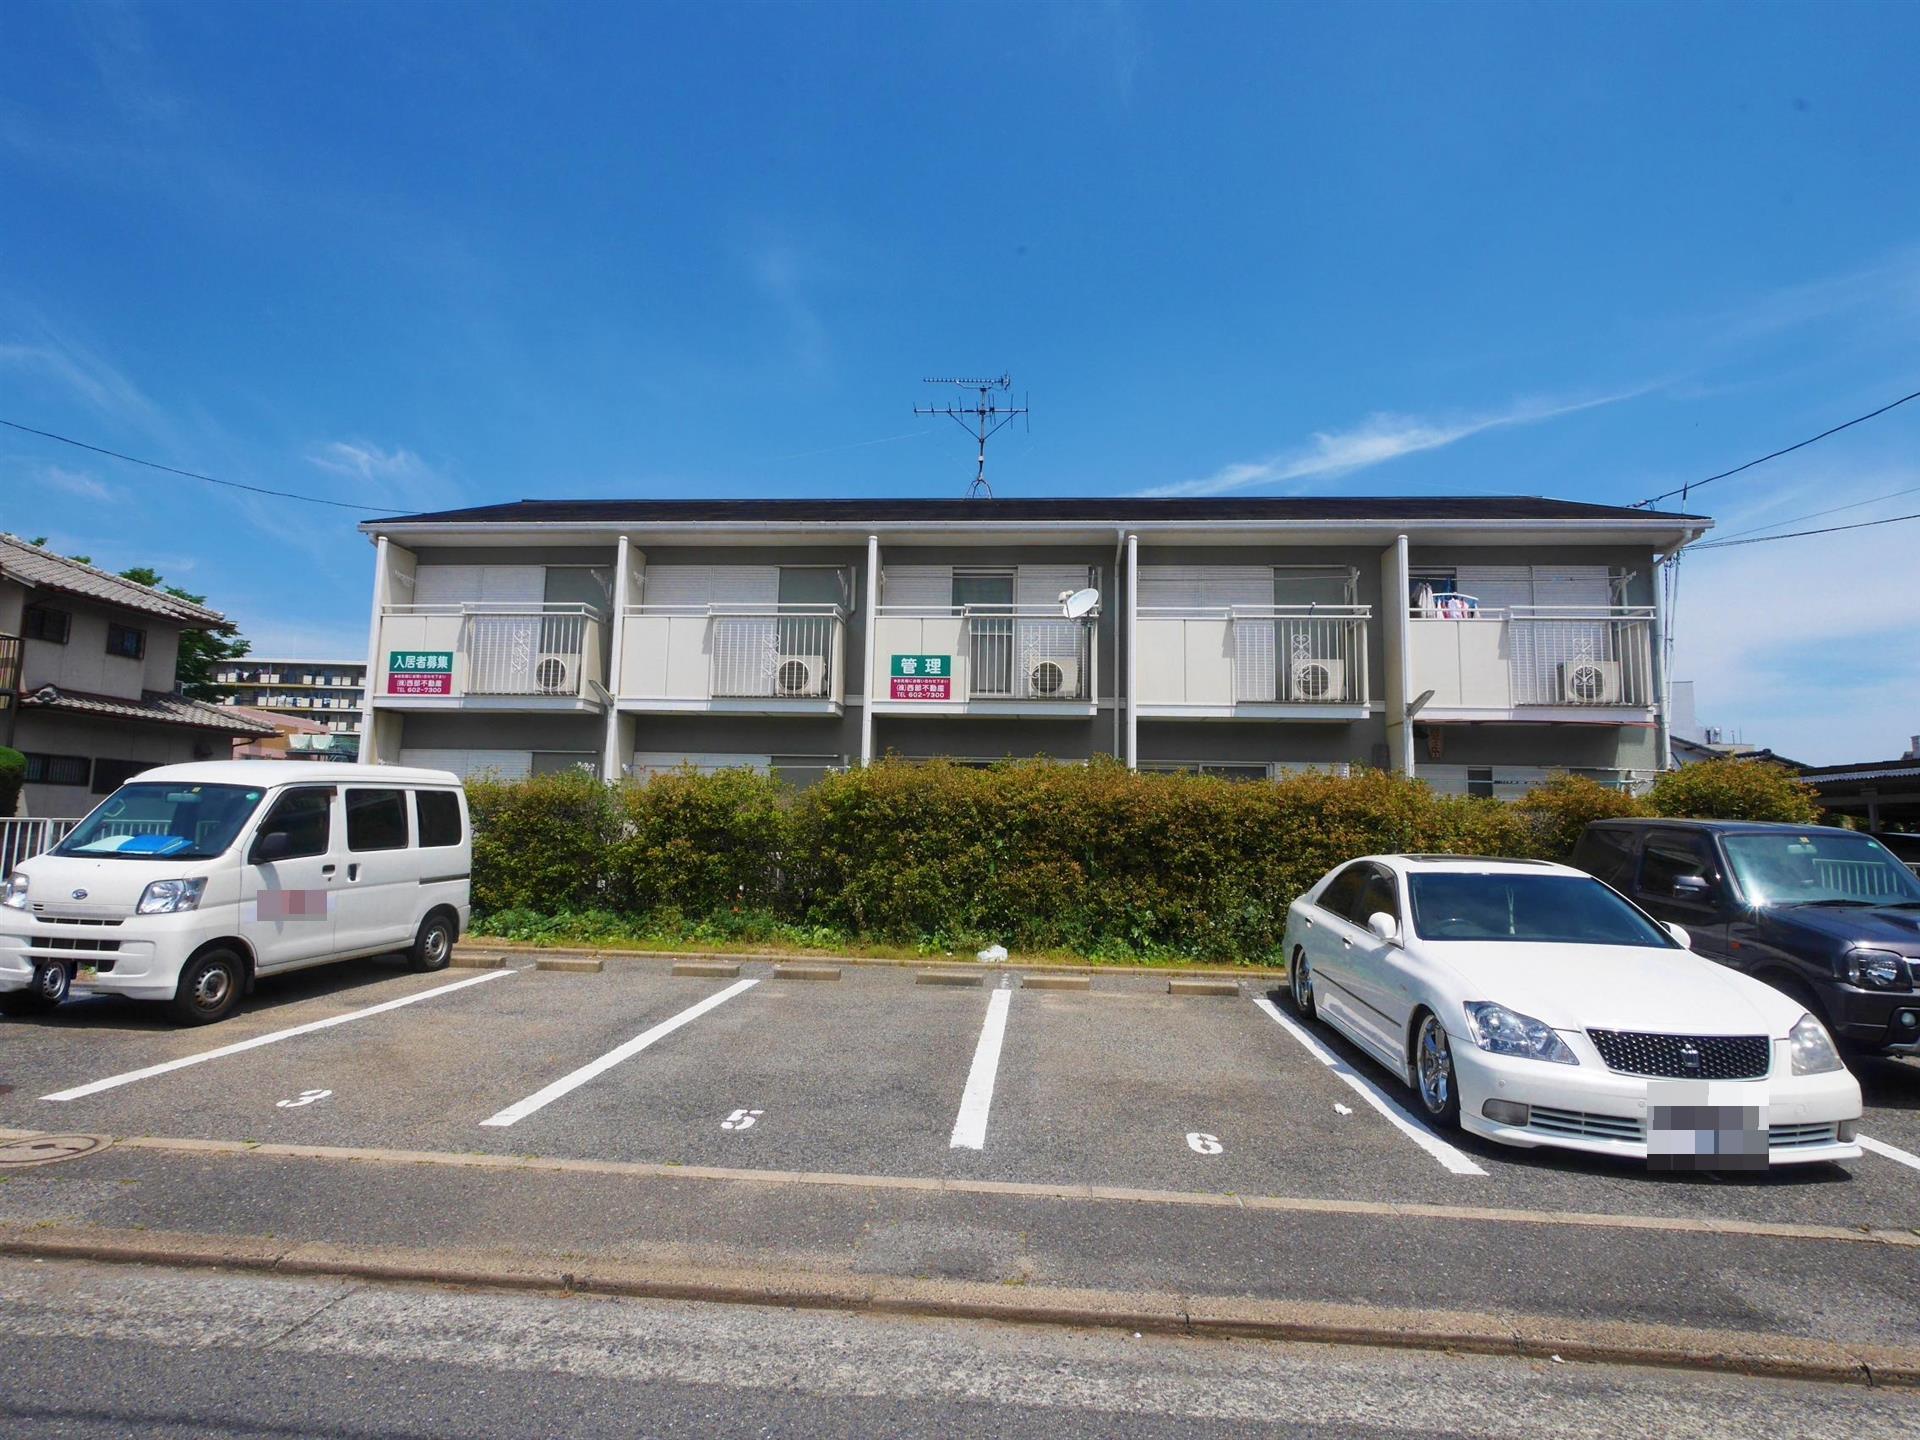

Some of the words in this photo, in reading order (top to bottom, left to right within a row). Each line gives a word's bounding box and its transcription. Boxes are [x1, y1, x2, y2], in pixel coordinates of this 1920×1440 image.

[393, 655, 448, 669] 入居者募集
[901, 658, 941, 674] 管理
[721, 1109, 765, 1129] 5
[1186, 1132, 1223, 1154] 6
